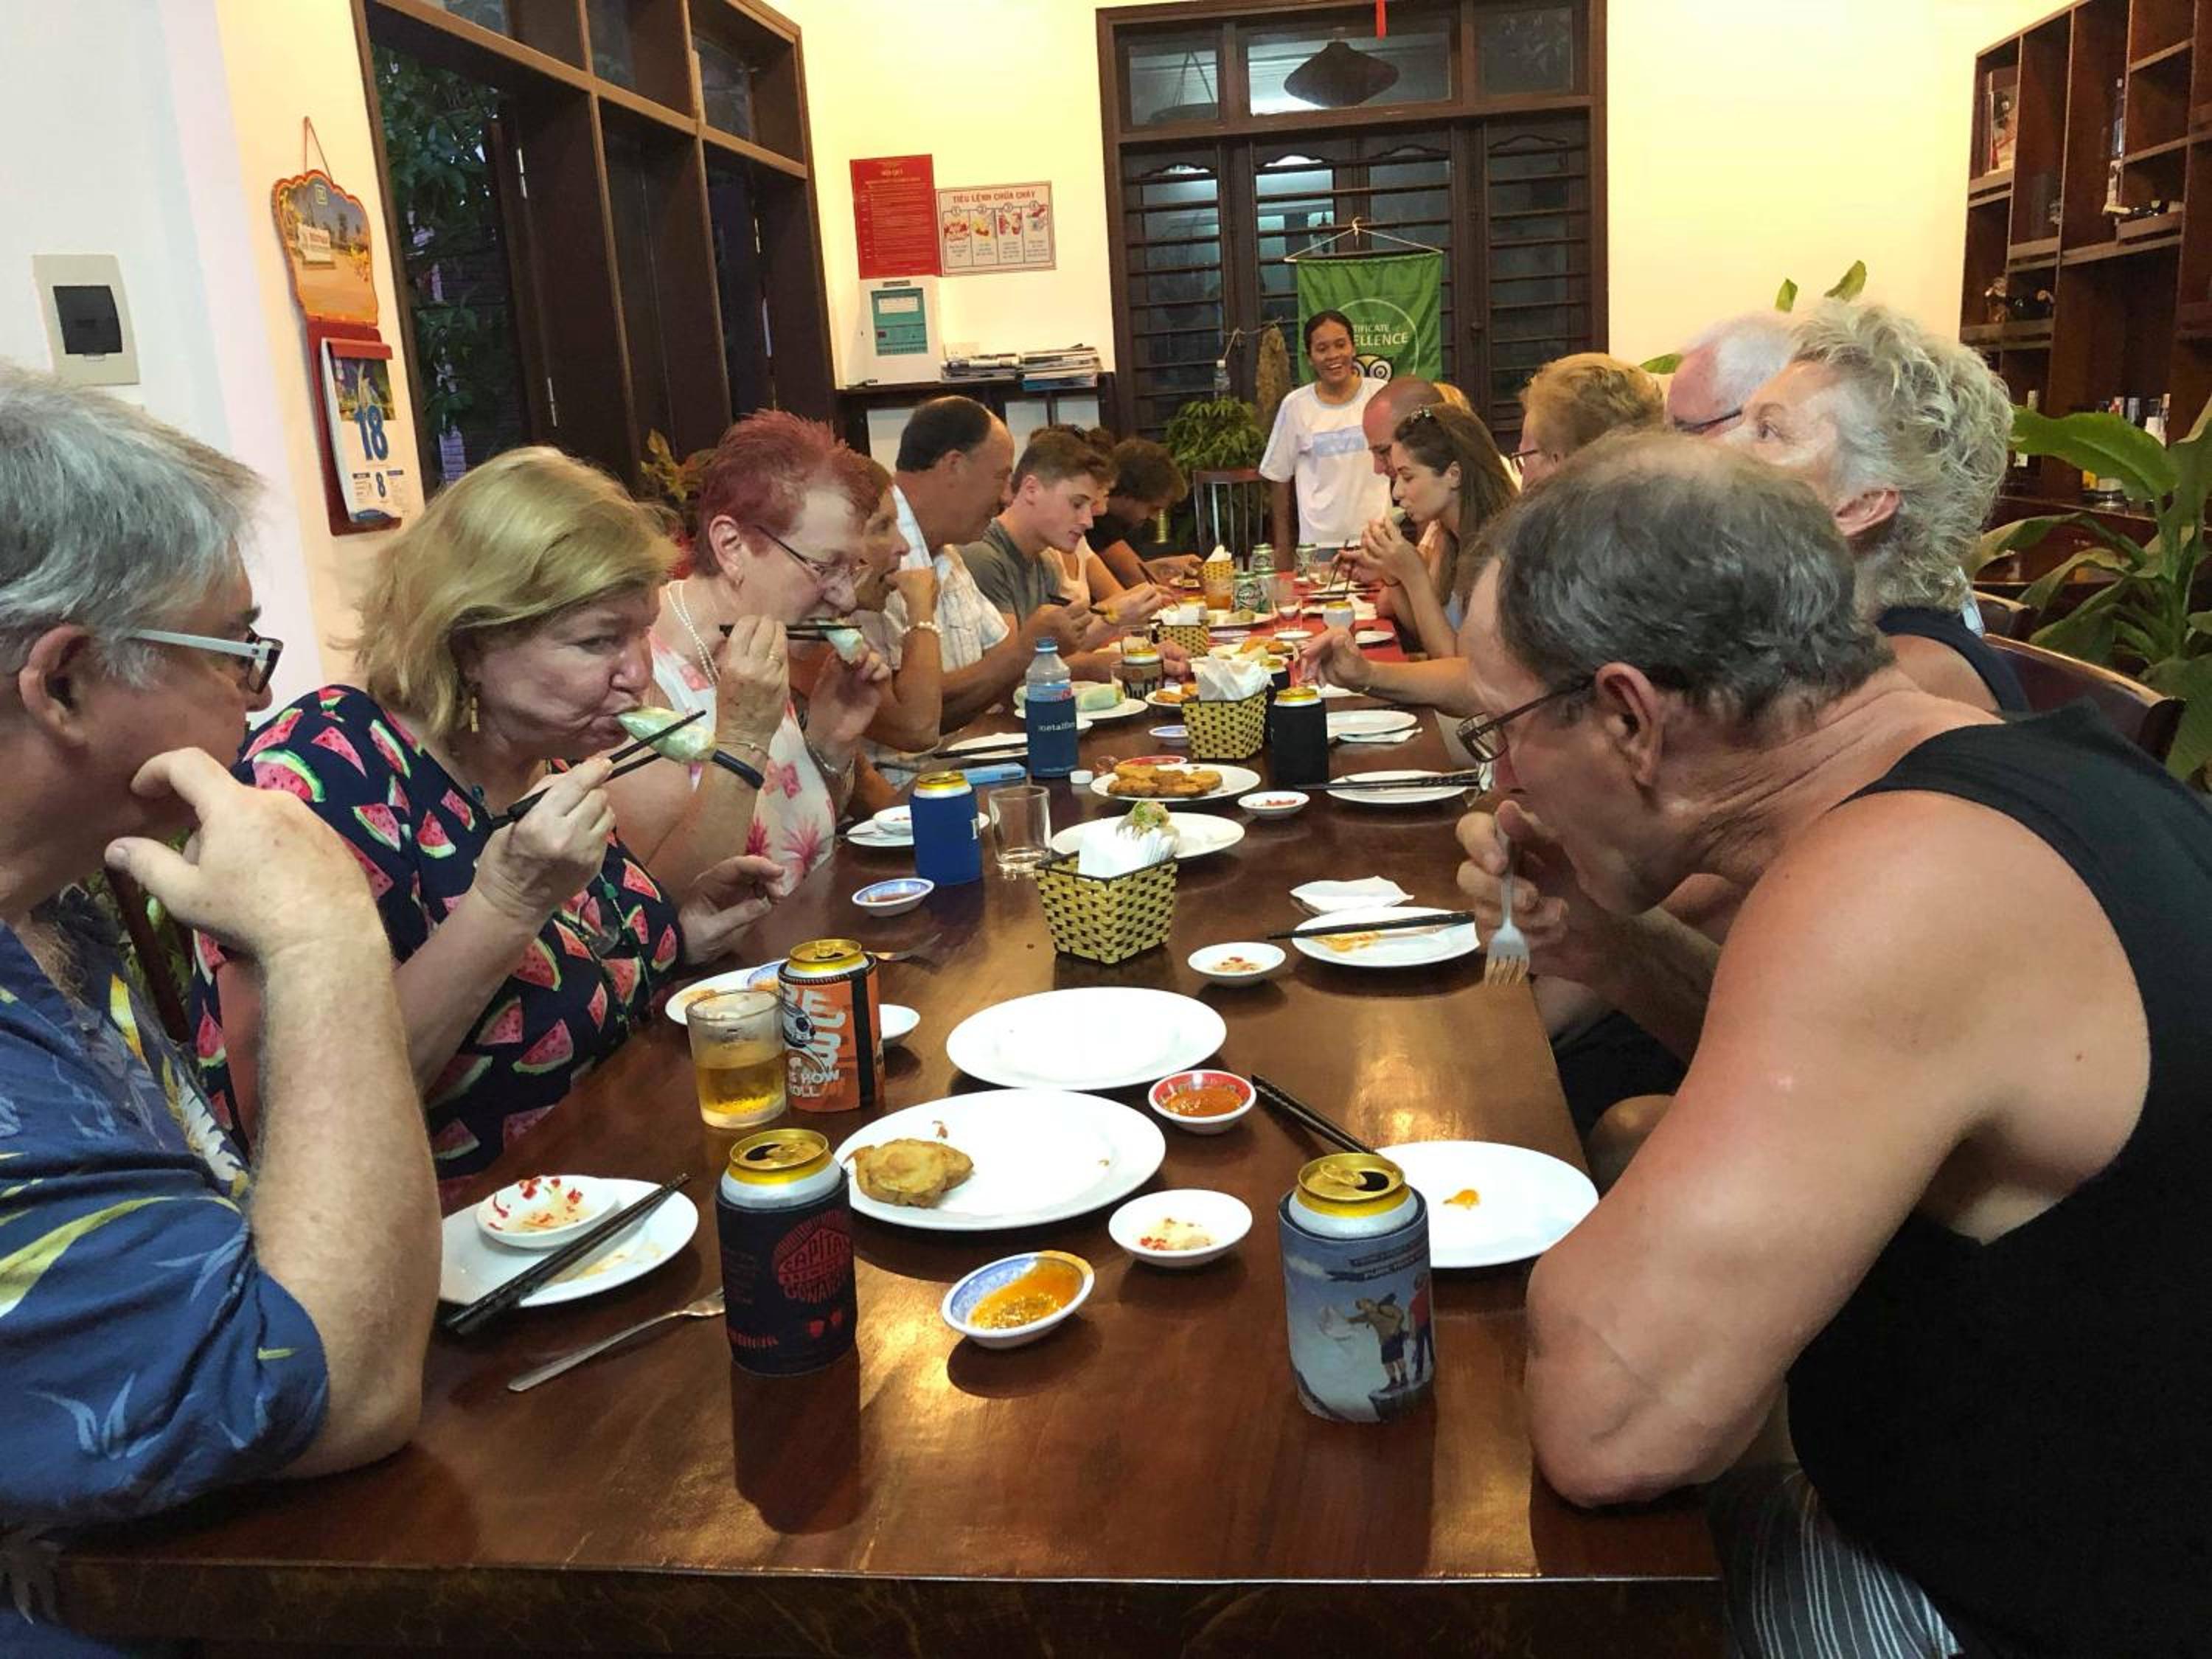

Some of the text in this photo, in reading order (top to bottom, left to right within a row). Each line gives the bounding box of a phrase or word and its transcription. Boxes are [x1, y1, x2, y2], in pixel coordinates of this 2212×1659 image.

[1353, 323, 1390, 333] TIFICATE
[1354, 332, 1409, 347] ELLENCE
[354, 405, 389, 461] 18
[375, 471, 386, 498] 8
